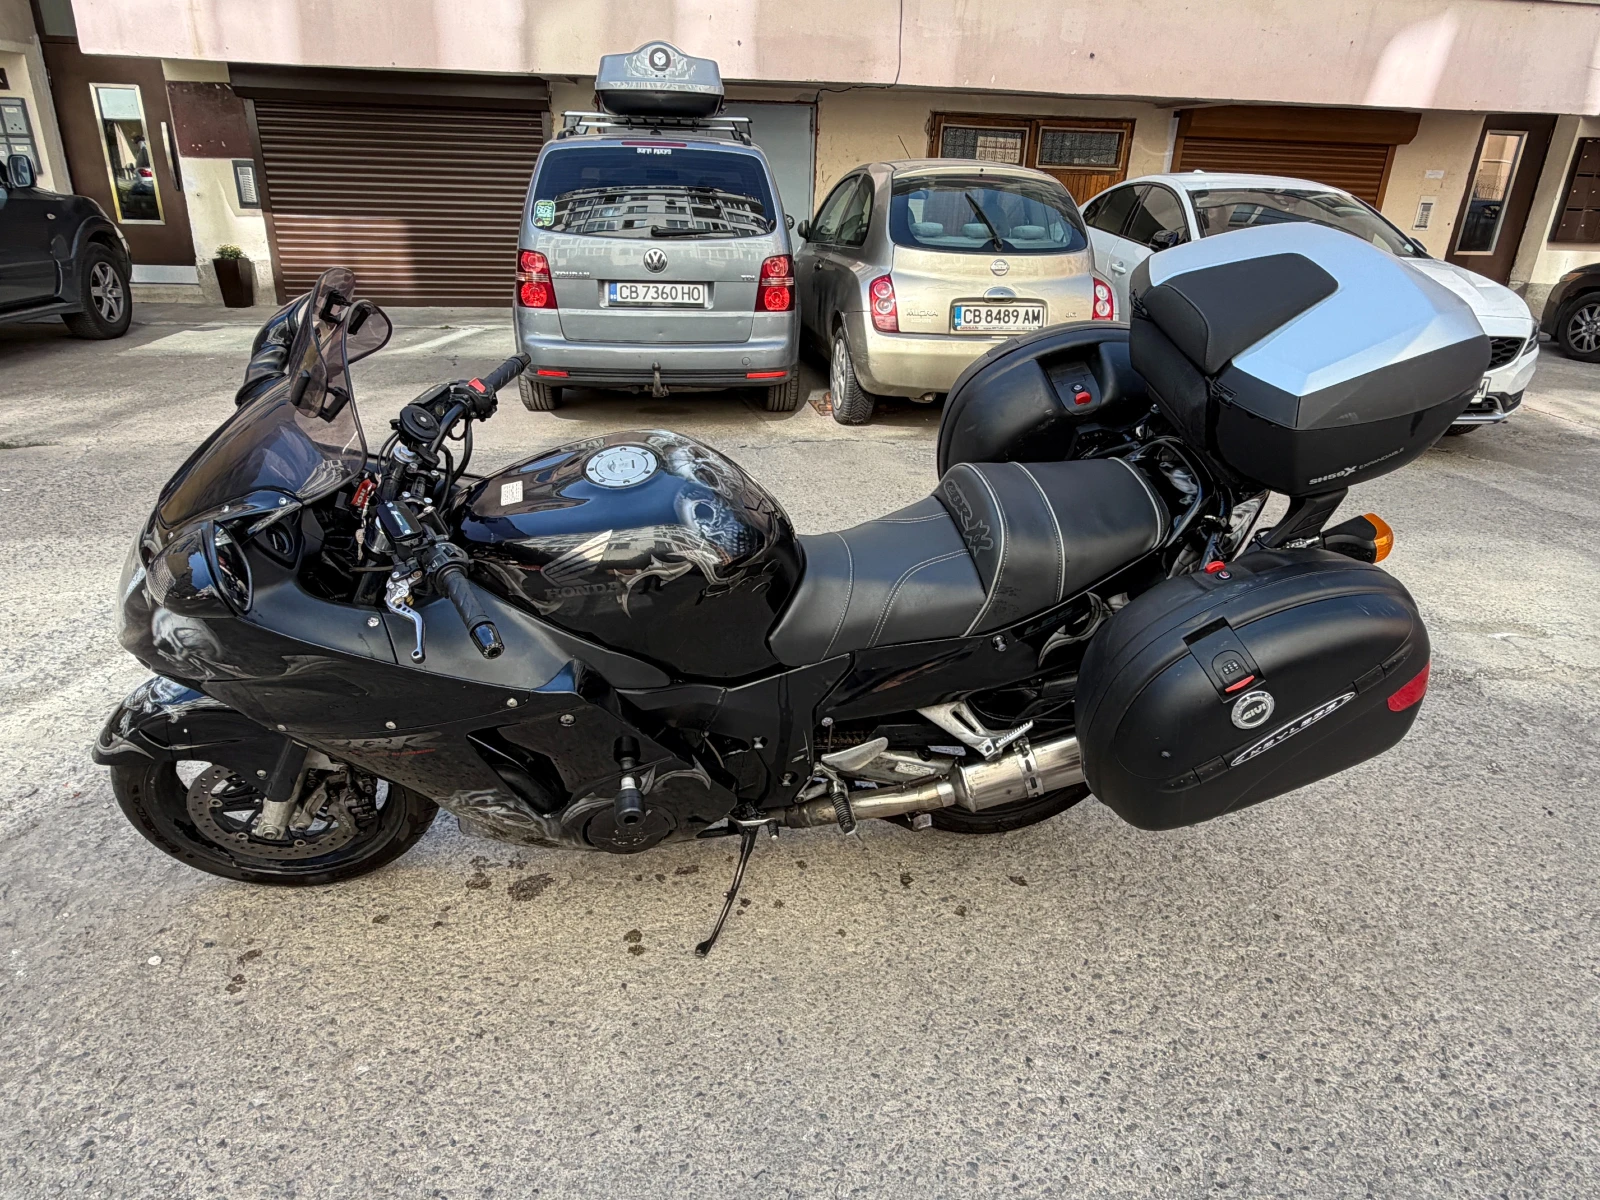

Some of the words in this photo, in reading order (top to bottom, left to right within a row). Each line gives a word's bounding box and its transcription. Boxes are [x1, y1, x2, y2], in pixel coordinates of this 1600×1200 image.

[619, 285, 639, 300] CB
[642, 285, 678, 300] 7360
[681, 286, 701, 301] HO
[963, 308, 981, 324] CB
[985, 309, 1020, 324] 8489
[1022, 309, 1041, 324] AM
[544, 581, 622, 600] HONDA
[1242, 702, 1268, 721] GIVI
